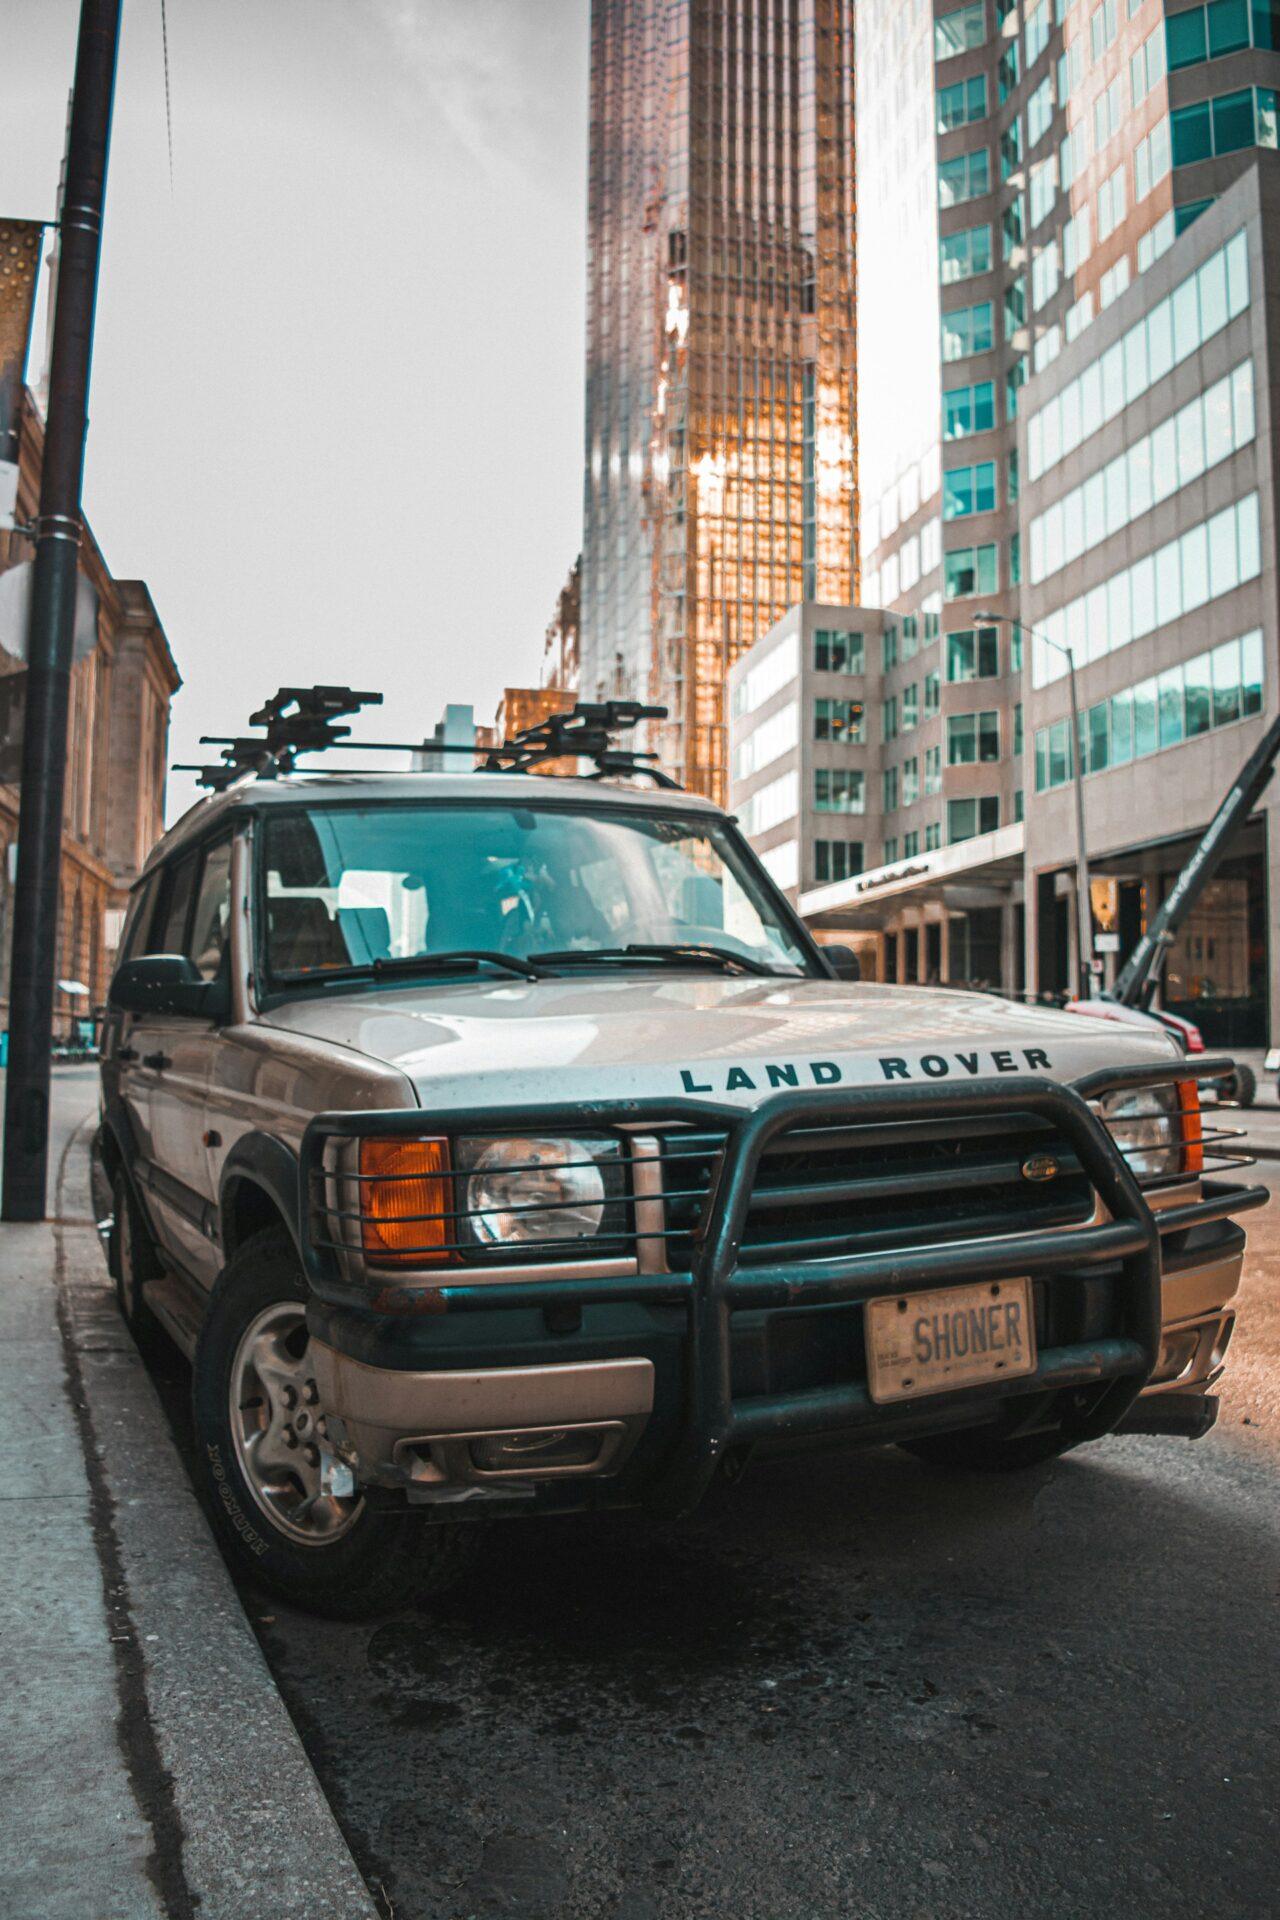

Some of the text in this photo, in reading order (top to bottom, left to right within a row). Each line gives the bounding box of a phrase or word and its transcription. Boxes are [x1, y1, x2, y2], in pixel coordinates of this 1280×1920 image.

[680, 1061, 842, 1093] LAND
[878, 1048, 1053, 1080] ROVER
[914, 1302, 1021, 1364] SHONER
